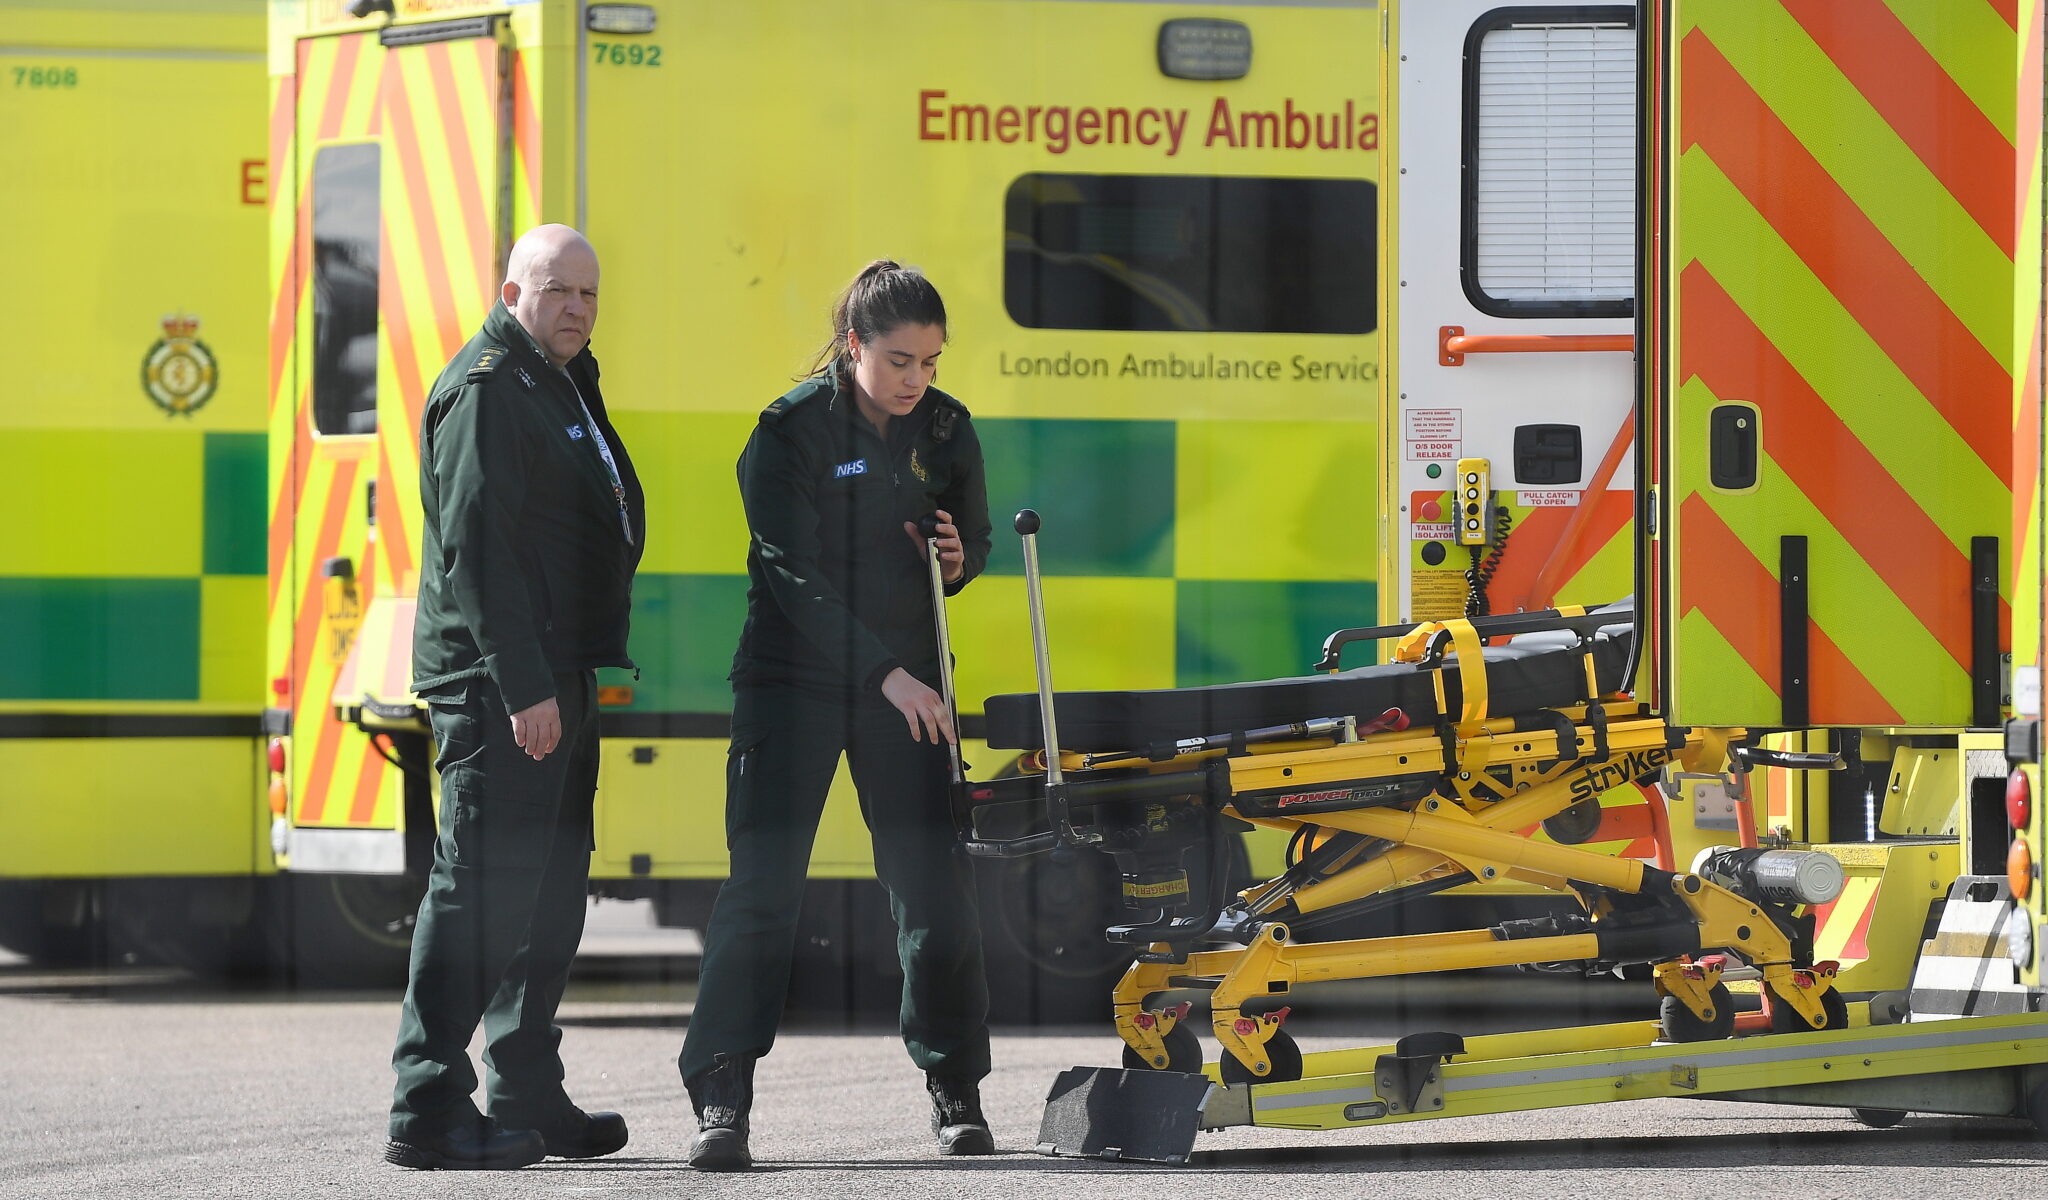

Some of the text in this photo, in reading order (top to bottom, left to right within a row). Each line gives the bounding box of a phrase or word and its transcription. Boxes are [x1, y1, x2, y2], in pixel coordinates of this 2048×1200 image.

[593, 43, 661, 66] 7692
[919, 89, 1188, 155] Emergency
[241, 159, 266, 205] E
[999, 350, 1108, 377] London
[1119, 352, 1282, 380] Ambulance
[836, 460, 865, 477] NHS
[1141, 882, 1184, 895] CHARGER
